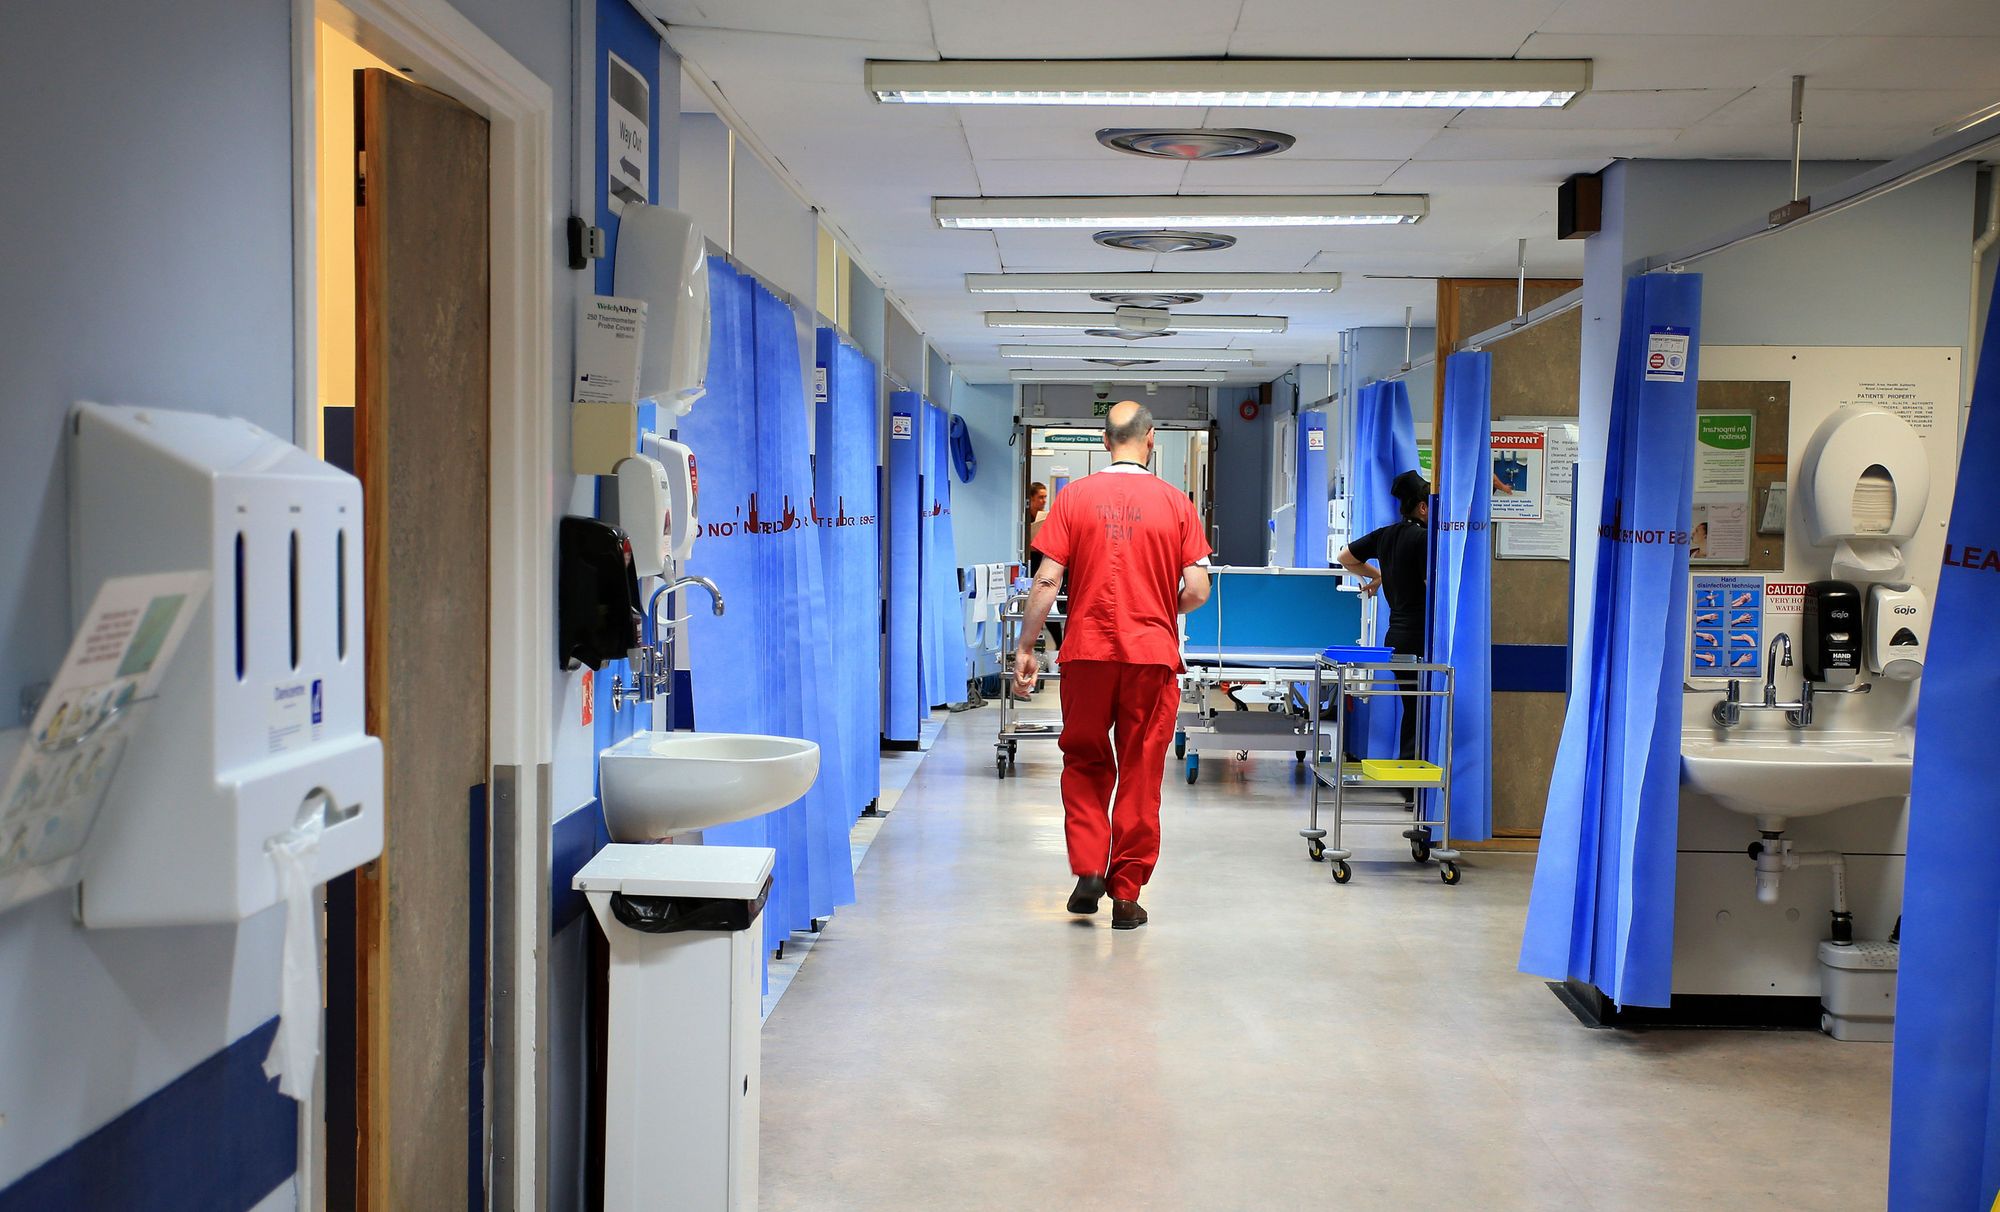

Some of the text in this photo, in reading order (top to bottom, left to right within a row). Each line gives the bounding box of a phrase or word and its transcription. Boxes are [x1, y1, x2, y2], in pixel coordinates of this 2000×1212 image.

[620, 121, 642, 153] Way Out
[599, 314, 636, 325] Thermometer
[598, 322, 635, 333] Probe Covers
[1491, 436, 1539, 444] PORTANT
[1096, 505, 1141, 522] TRAUMA
[1105, 524, 1132, 541] TEAM
[1635, 530, 1665, 544] NOT
